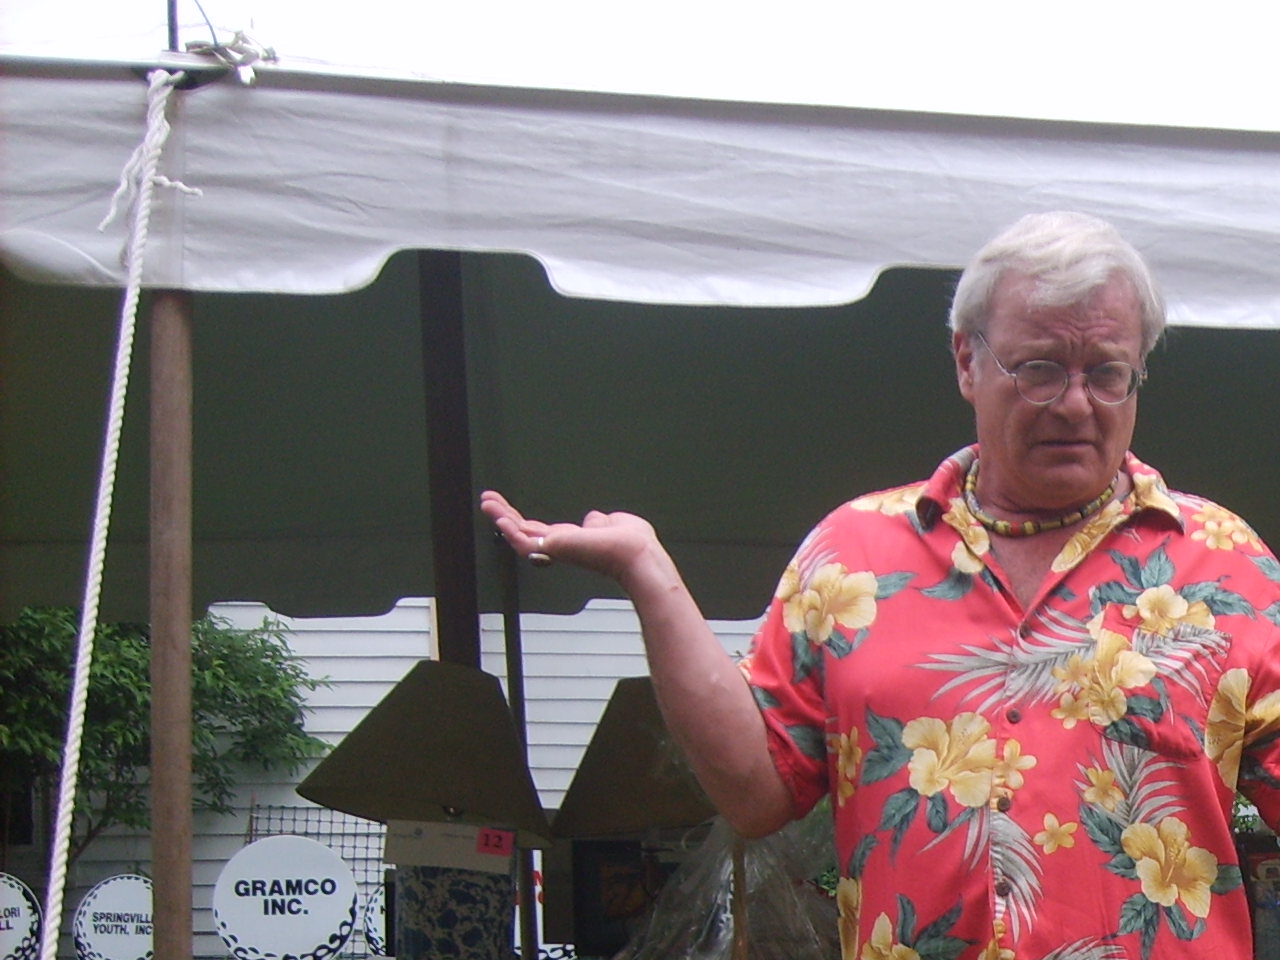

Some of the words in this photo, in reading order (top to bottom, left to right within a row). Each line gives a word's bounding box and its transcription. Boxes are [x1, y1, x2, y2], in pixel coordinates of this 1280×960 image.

[483, 833, 503, 848] 12
[234, 879, 337, 897] GRAMCO
[263, 899, 309, 916] INC.
[92, 912, 153, 924] SPRINGVILL
